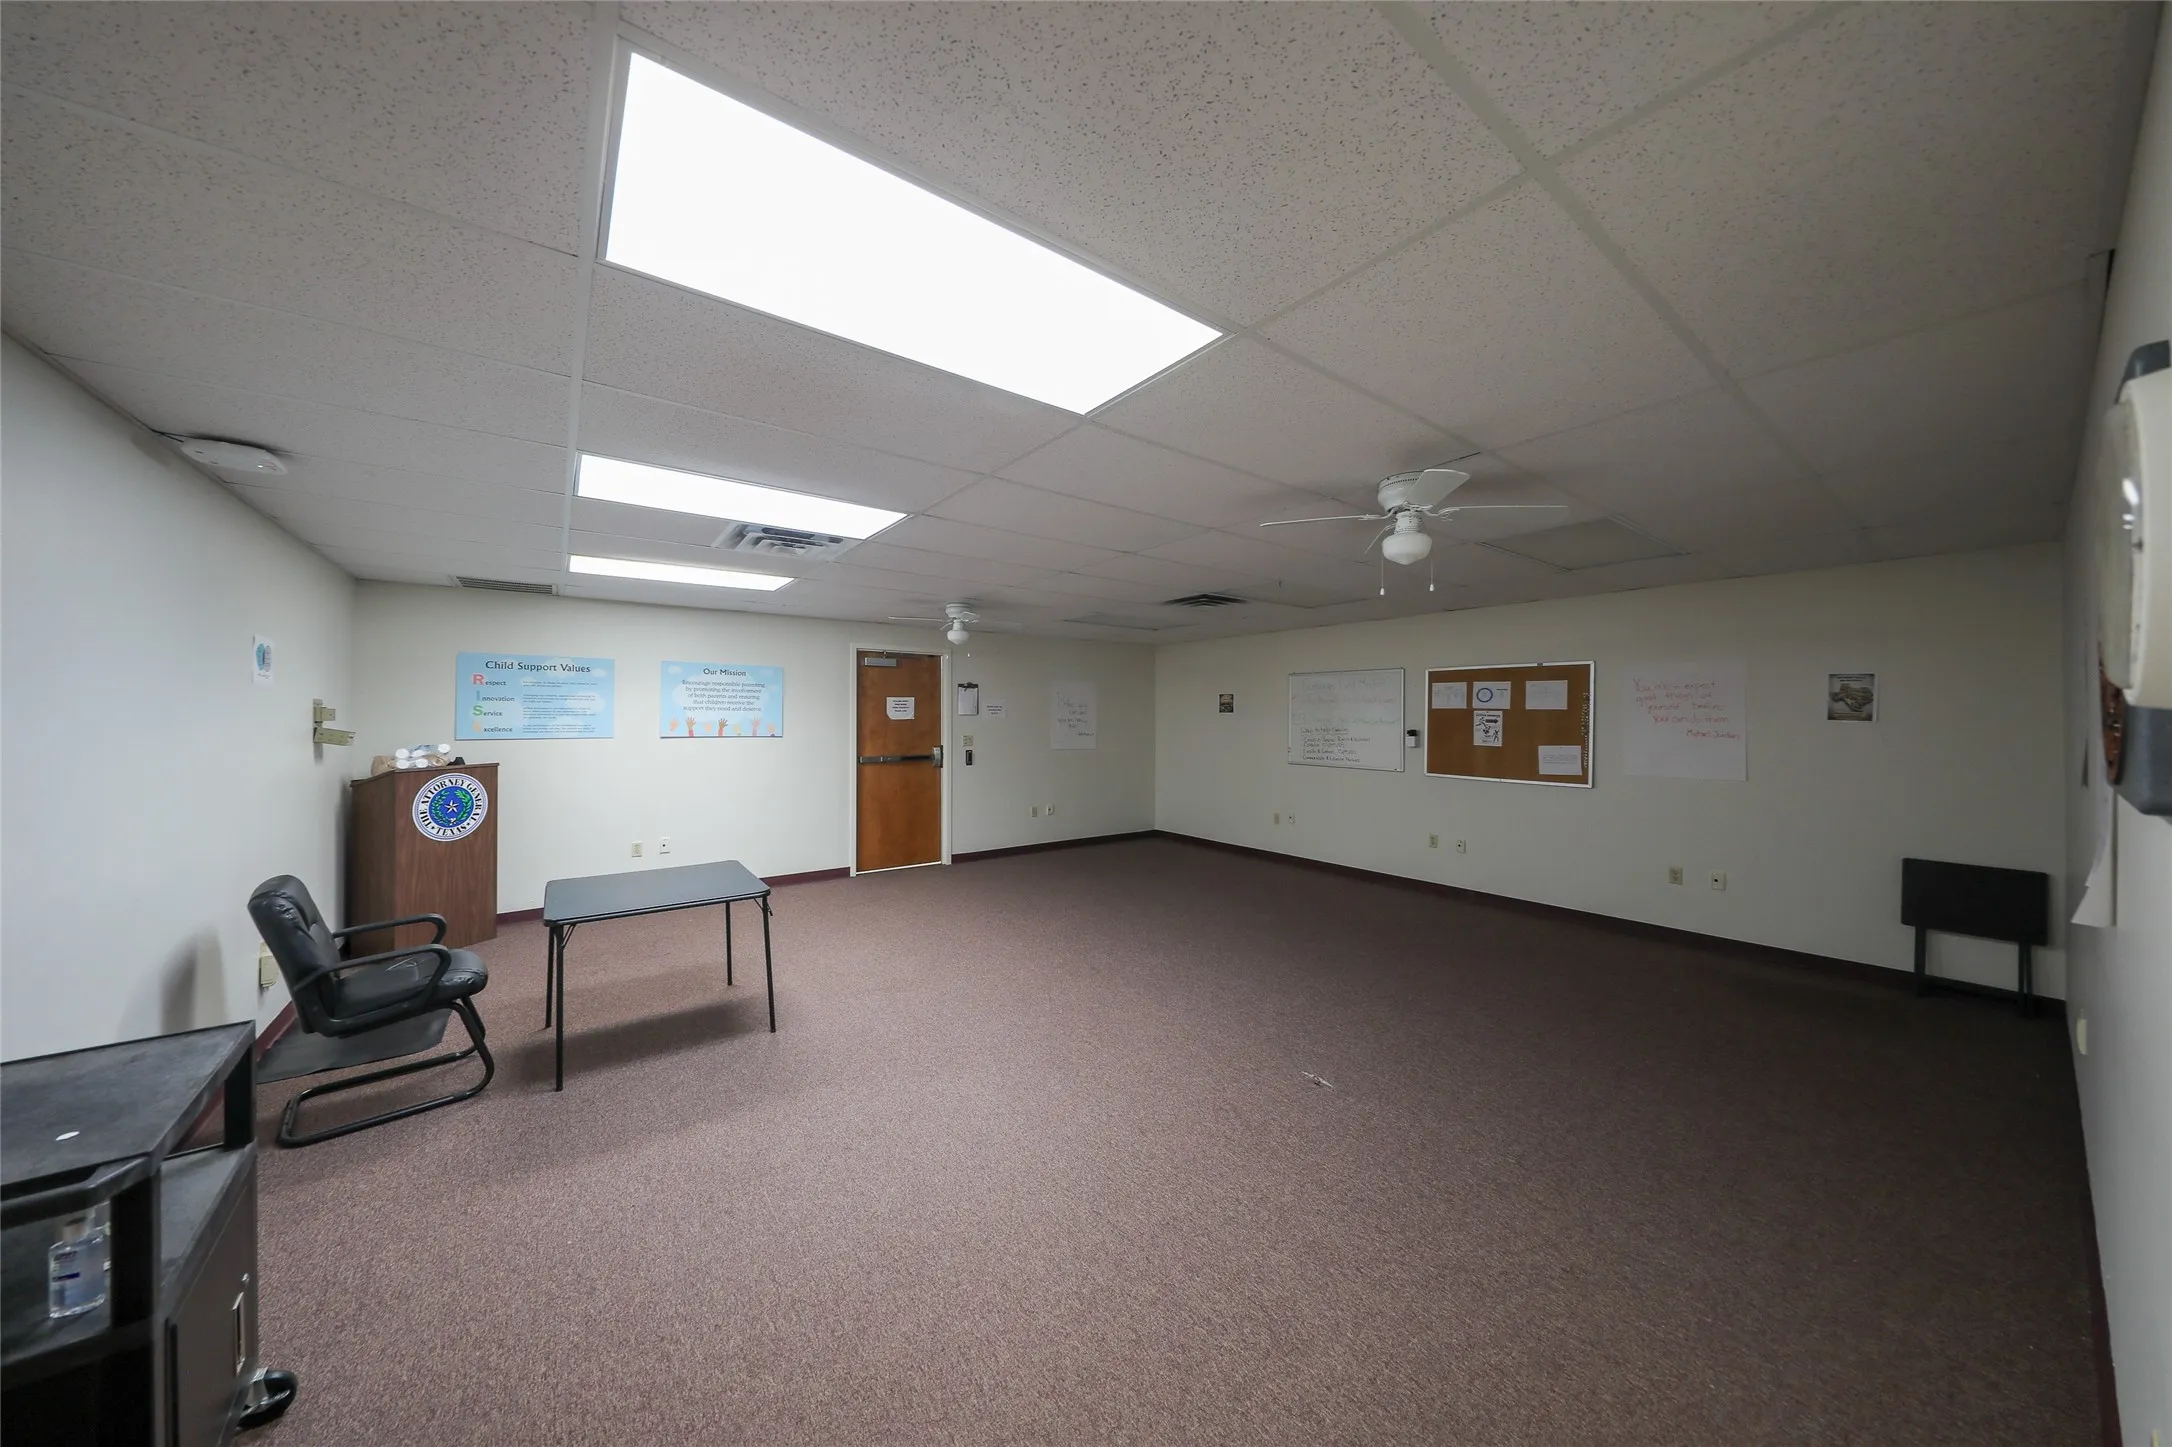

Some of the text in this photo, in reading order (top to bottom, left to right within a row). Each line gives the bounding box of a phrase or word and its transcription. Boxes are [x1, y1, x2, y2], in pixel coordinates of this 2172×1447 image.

[485, 660, 591, 673] Child Support Values
[703, 668, 746, 677] Our Mission
[472, 673, 507, 686] Respect
[476, 690, 515, 702] Innovation
[472, 705, 502, 717] Service
[420, 779, 482, 828] THE ATTORNEY GENERAL
[436, 825, 467, 836] TEXAS
